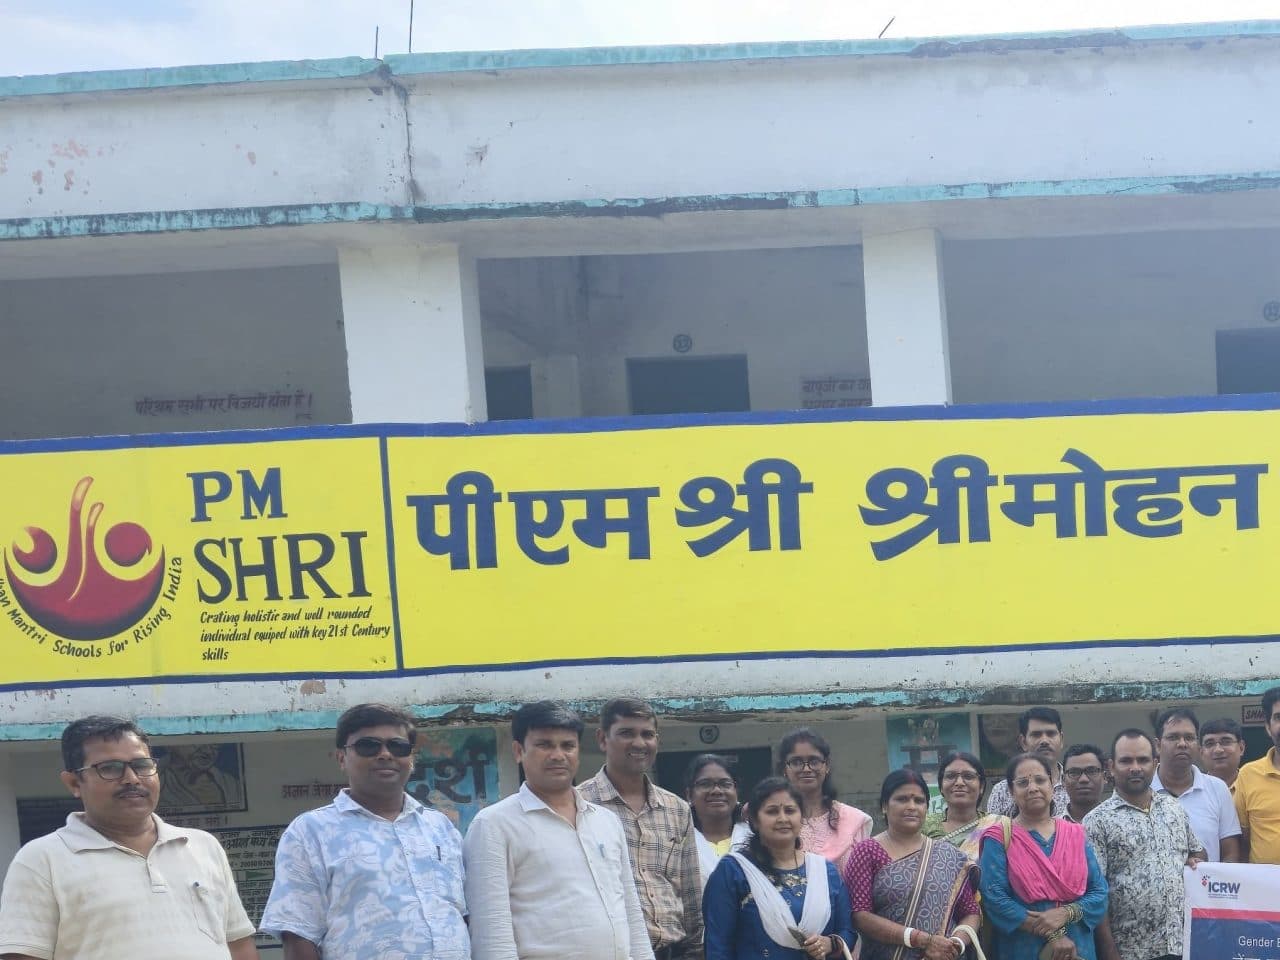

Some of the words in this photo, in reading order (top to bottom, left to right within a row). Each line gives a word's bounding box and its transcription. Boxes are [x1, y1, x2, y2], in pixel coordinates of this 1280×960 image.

[187, 467, 288, 522] PM
[407, 471, 660, 570] पीएम
[675, 459, 813, 557] श्री
[189, 530, 373, 605] SHRI
[7, 608, 48, 645] Mantri
[52, 639, 103, 658] Schools
[106, 640, 129, 656] for
[132, 606, 172, 644] Rising
[163, 556, 182, 602] India
[243, 608, 280, 623] holistic
[281, 608, 301, 621] and
[327, 605, 372, 620] rounded
[289, 625, 310, 639] with
[202, 648, 229, 661] skills
[1208, 881, 1240, 894] ICRW
[1238, 935, 1274, 947] Gender
